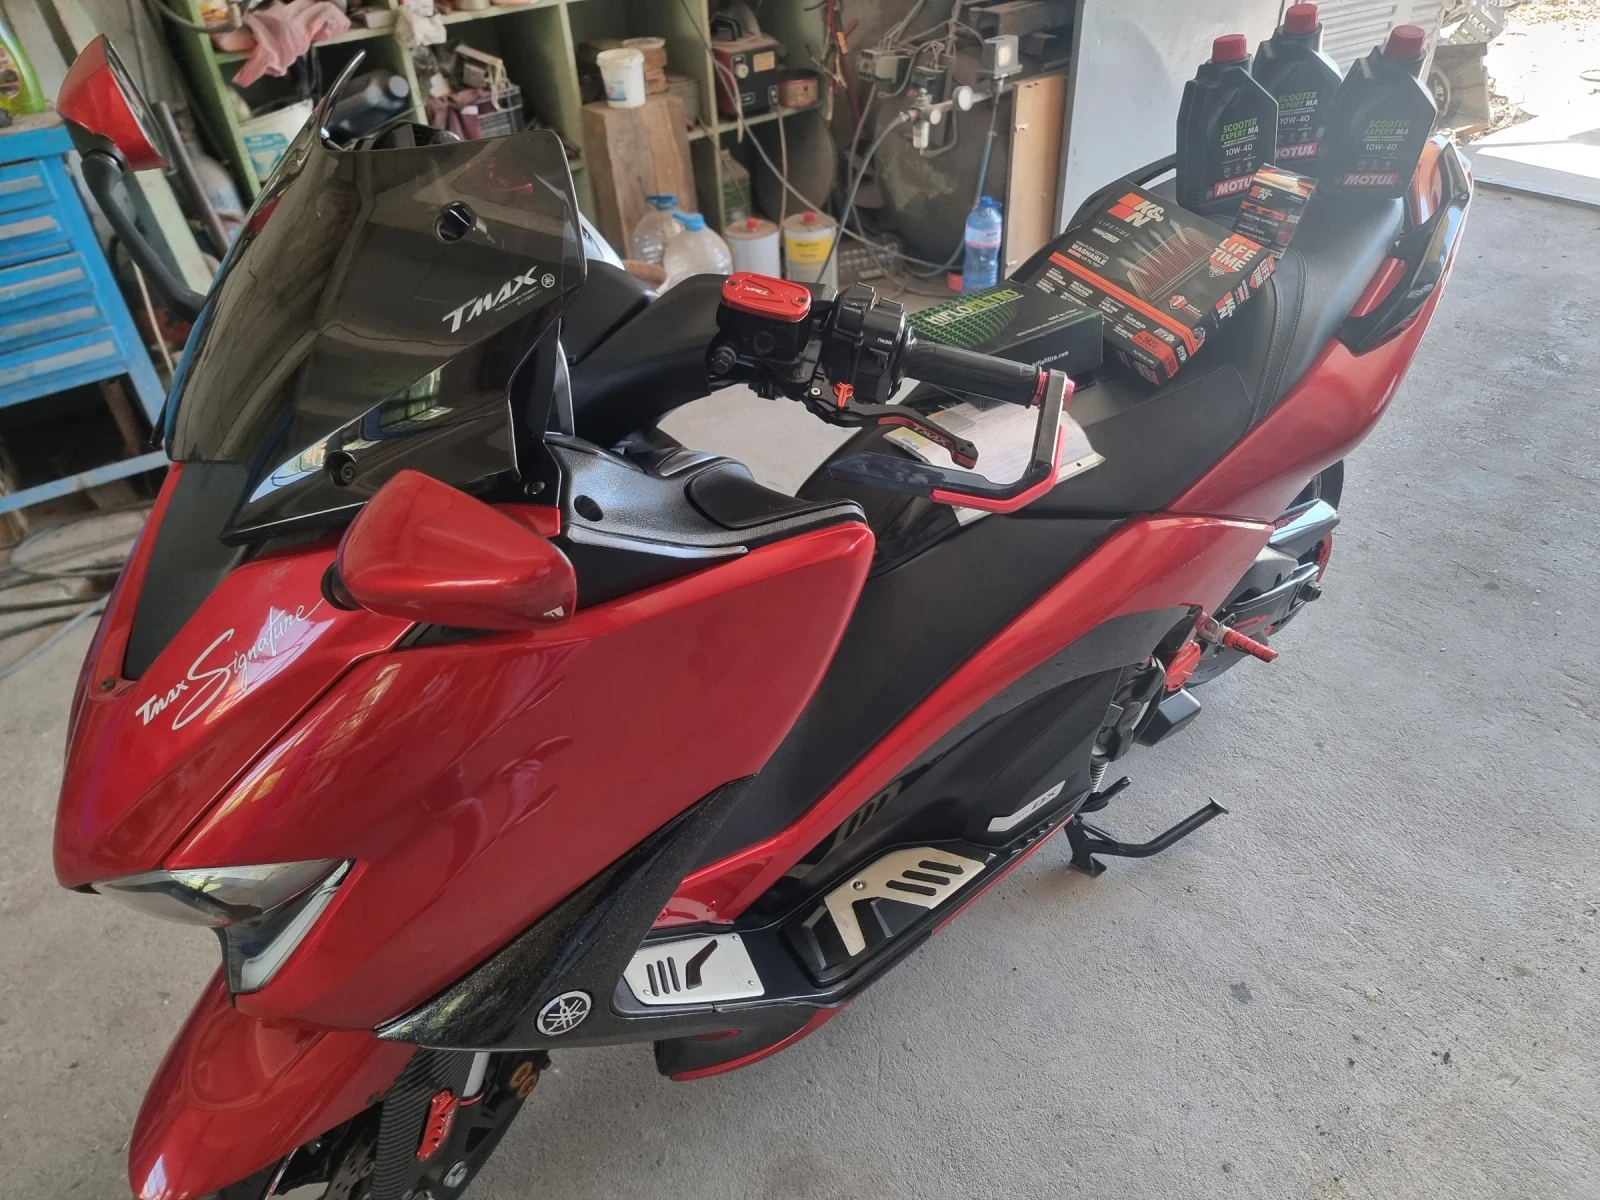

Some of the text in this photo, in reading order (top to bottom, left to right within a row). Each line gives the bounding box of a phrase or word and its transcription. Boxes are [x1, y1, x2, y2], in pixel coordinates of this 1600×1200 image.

[1278, 91, 1317, 103] SCOOTER
[1278, 98, 1318, 110] XPERT MA
[1223, 118, 1258, 134] SCOOTER
[1280, 114, 1310, 124] 10W-40
[1368, 120, 1410, 128] SCOOTER
[1220, 128, 1247, 142] EXPERT
[1248, 125, 1258, 134] MA
[1226, 143, 1252, 156] 10W-40
[1344, 174, 1394, 184] MOTUL
[1098, 220, 1132, 237] LIFETIME
[1071, 243, 1107, 266] WASHABLE
[1218, 238, 1258, 261] LIFE
[1209, 248, 1247, 272] TIME
[442, 265, 538, 333] TMAX
[925, 288, 1020, 325] HIFLOFILTRO
[877, 337, 893, 345] MENU
[172, 597, 325, 731] Signature
